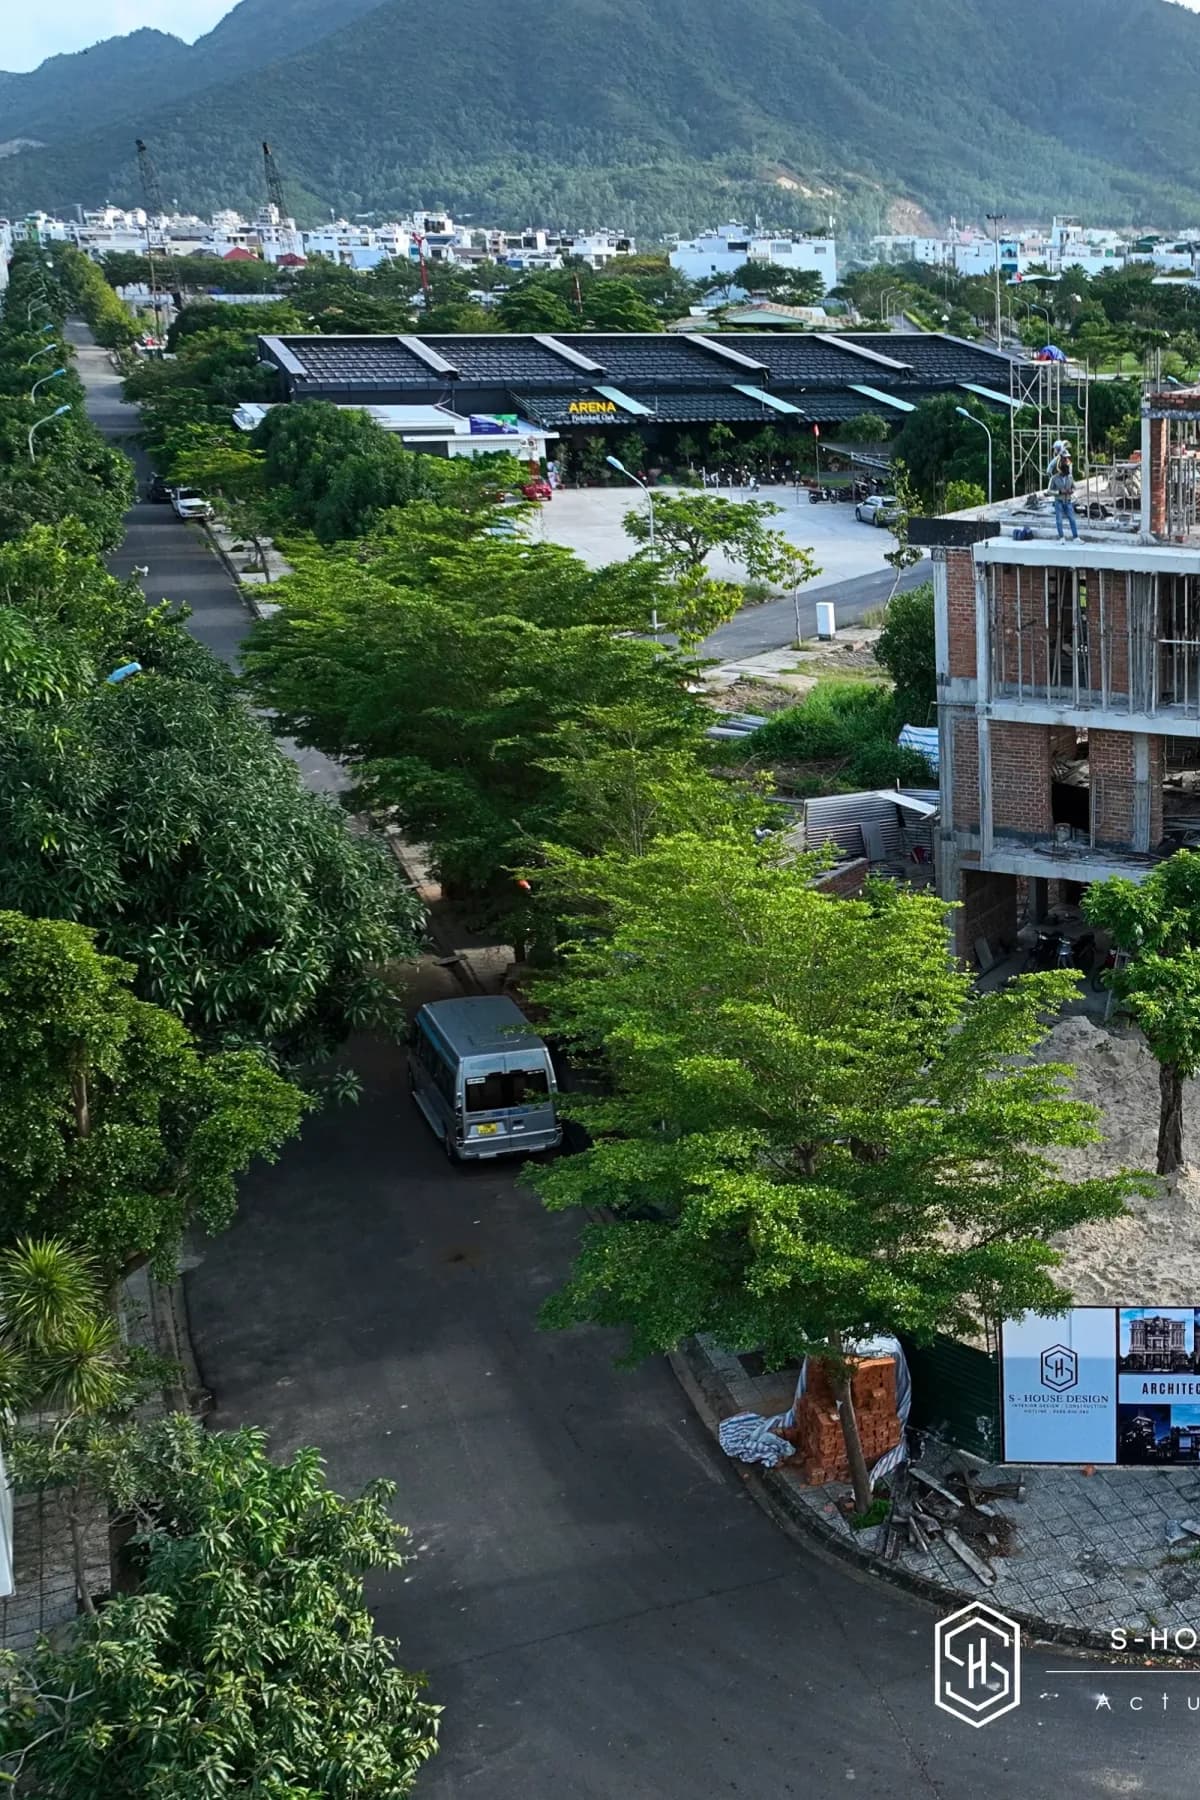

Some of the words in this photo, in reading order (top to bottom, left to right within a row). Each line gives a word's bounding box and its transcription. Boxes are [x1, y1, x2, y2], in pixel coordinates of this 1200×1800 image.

[569, 402, 617, 413] ARENA
[1008, 1394, 1015, 1402] S
[1024, 1394, 1062, 1403] HOUSE
[1066, 1394, 1109, 1403] DESIGN
